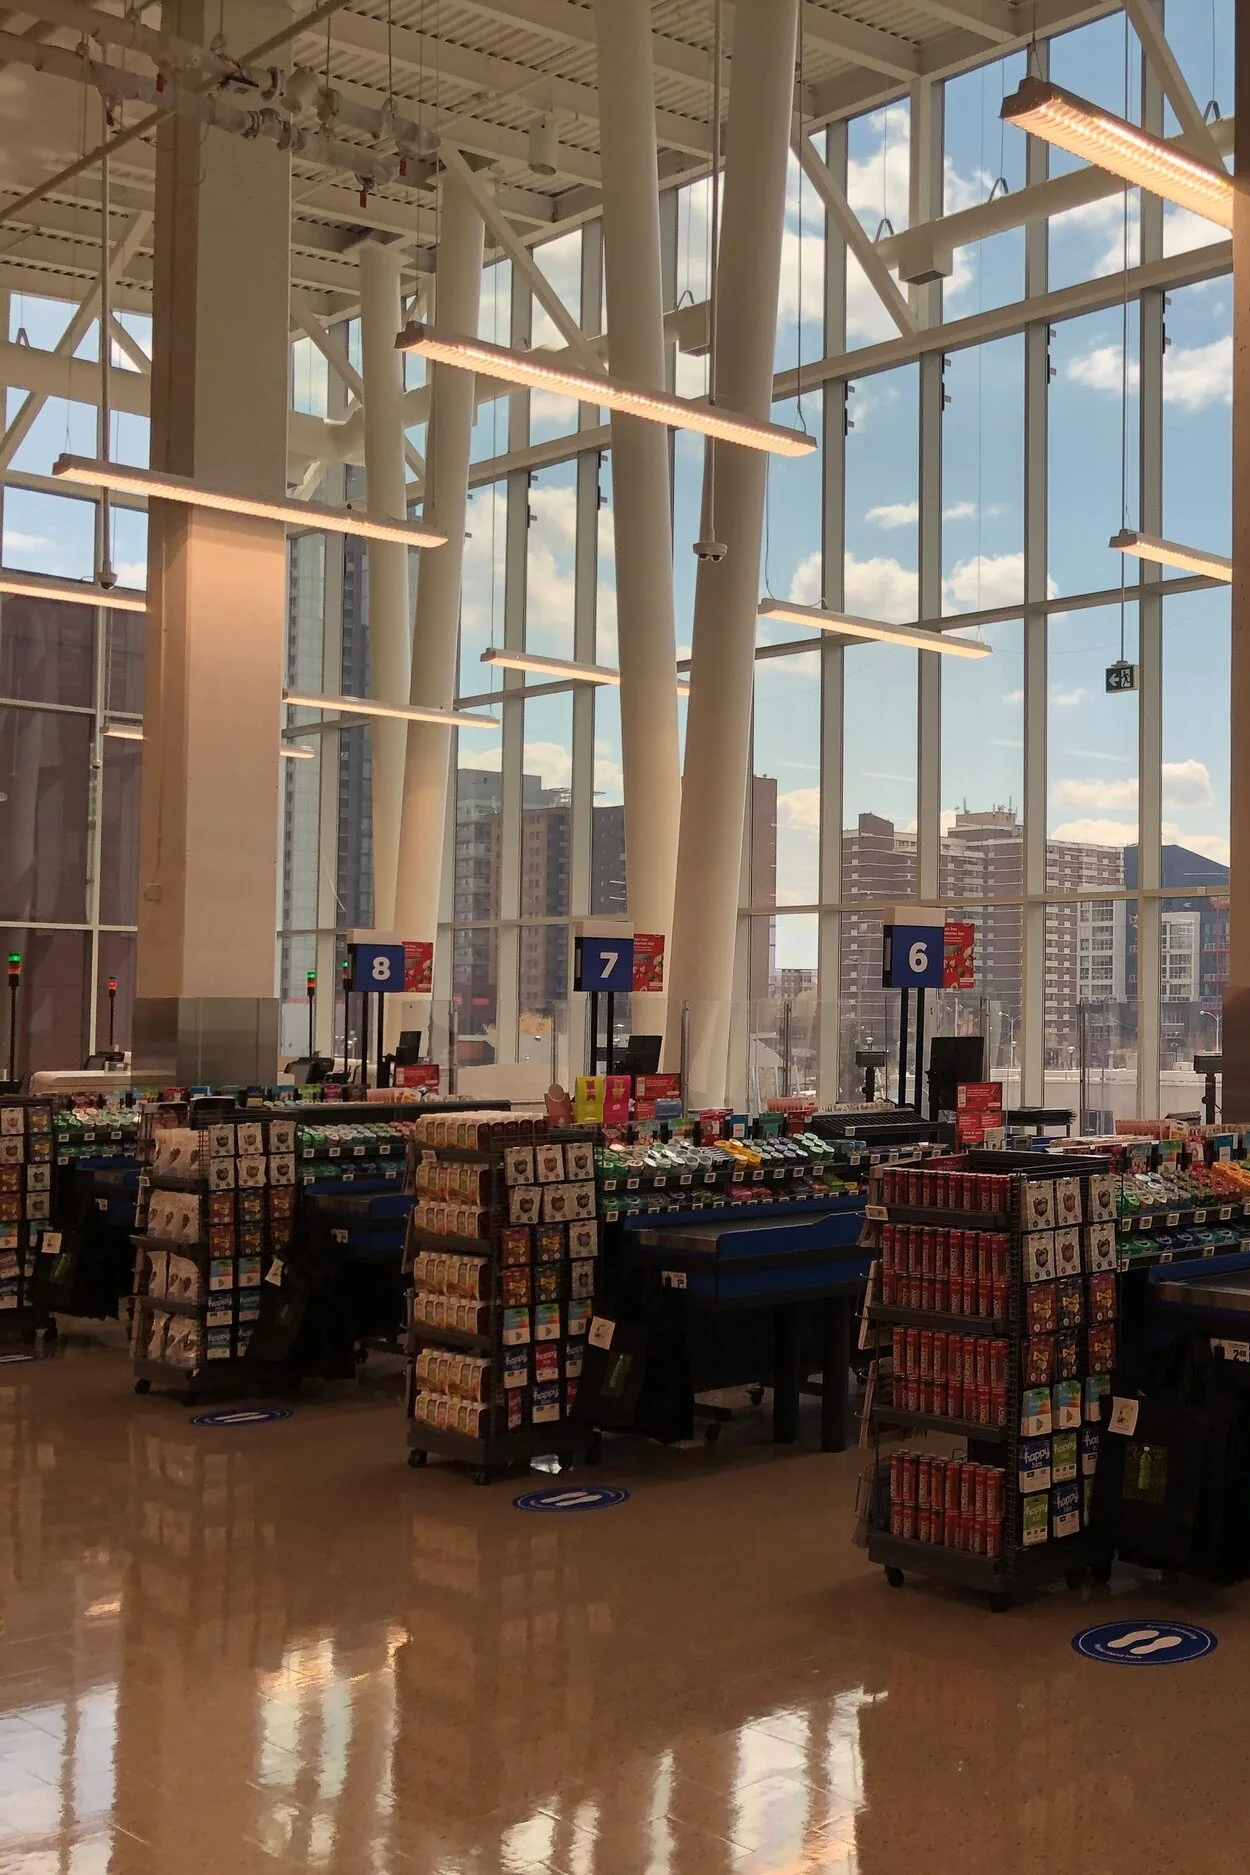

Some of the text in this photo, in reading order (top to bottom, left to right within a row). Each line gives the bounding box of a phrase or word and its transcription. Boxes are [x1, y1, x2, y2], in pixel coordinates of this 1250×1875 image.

[599, 951, 619, 979] 7
[908, 941, 929, 973] 6
[371, 956, 391, 981] 8
[1021, 1446, 1051, 1464] happy
[1054, 1441, 1077, 1454] happy
[1054, 1491, 1080, 1508] happy
